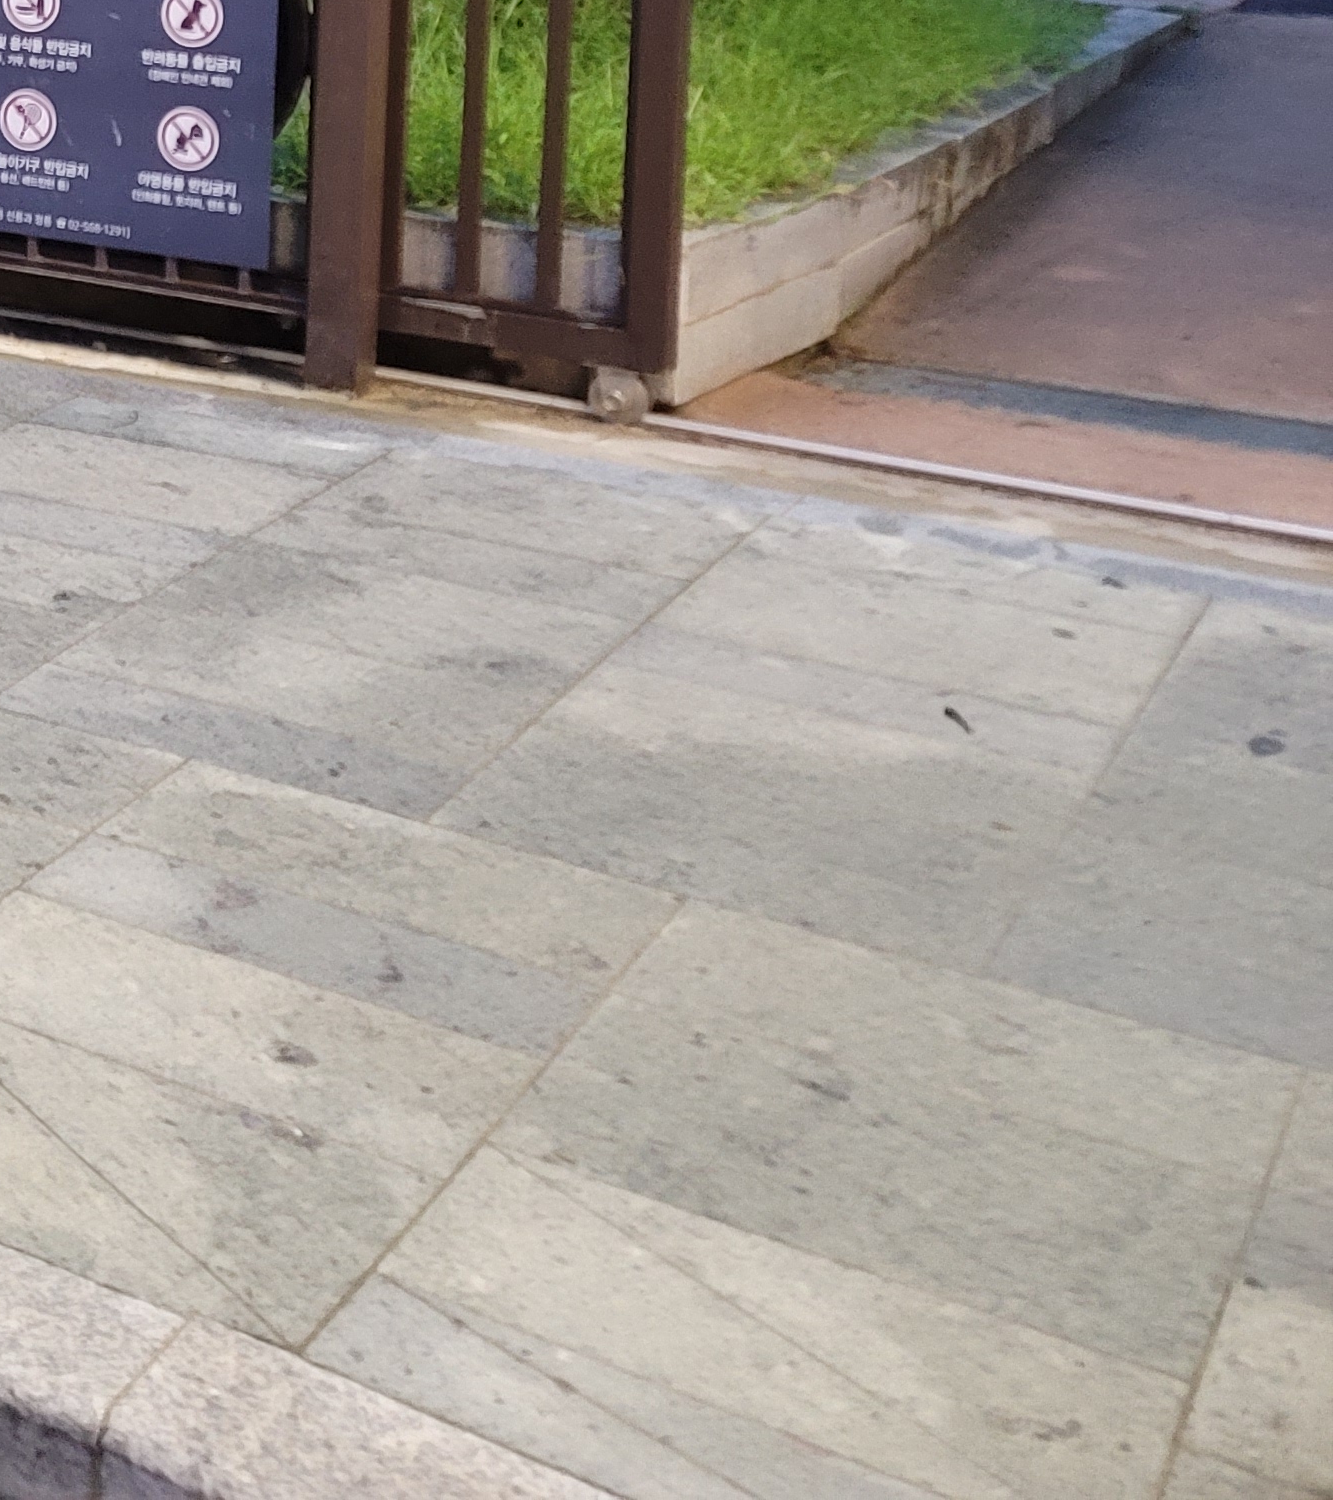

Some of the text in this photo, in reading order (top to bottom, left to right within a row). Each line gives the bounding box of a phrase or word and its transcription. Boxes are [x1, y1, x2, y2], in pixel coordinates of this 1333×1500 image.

[46, 38, 92, 58] 반입금지
[43, 158, 89, 180] 반입금지
[188, 177, 237, 199] 반입금지
